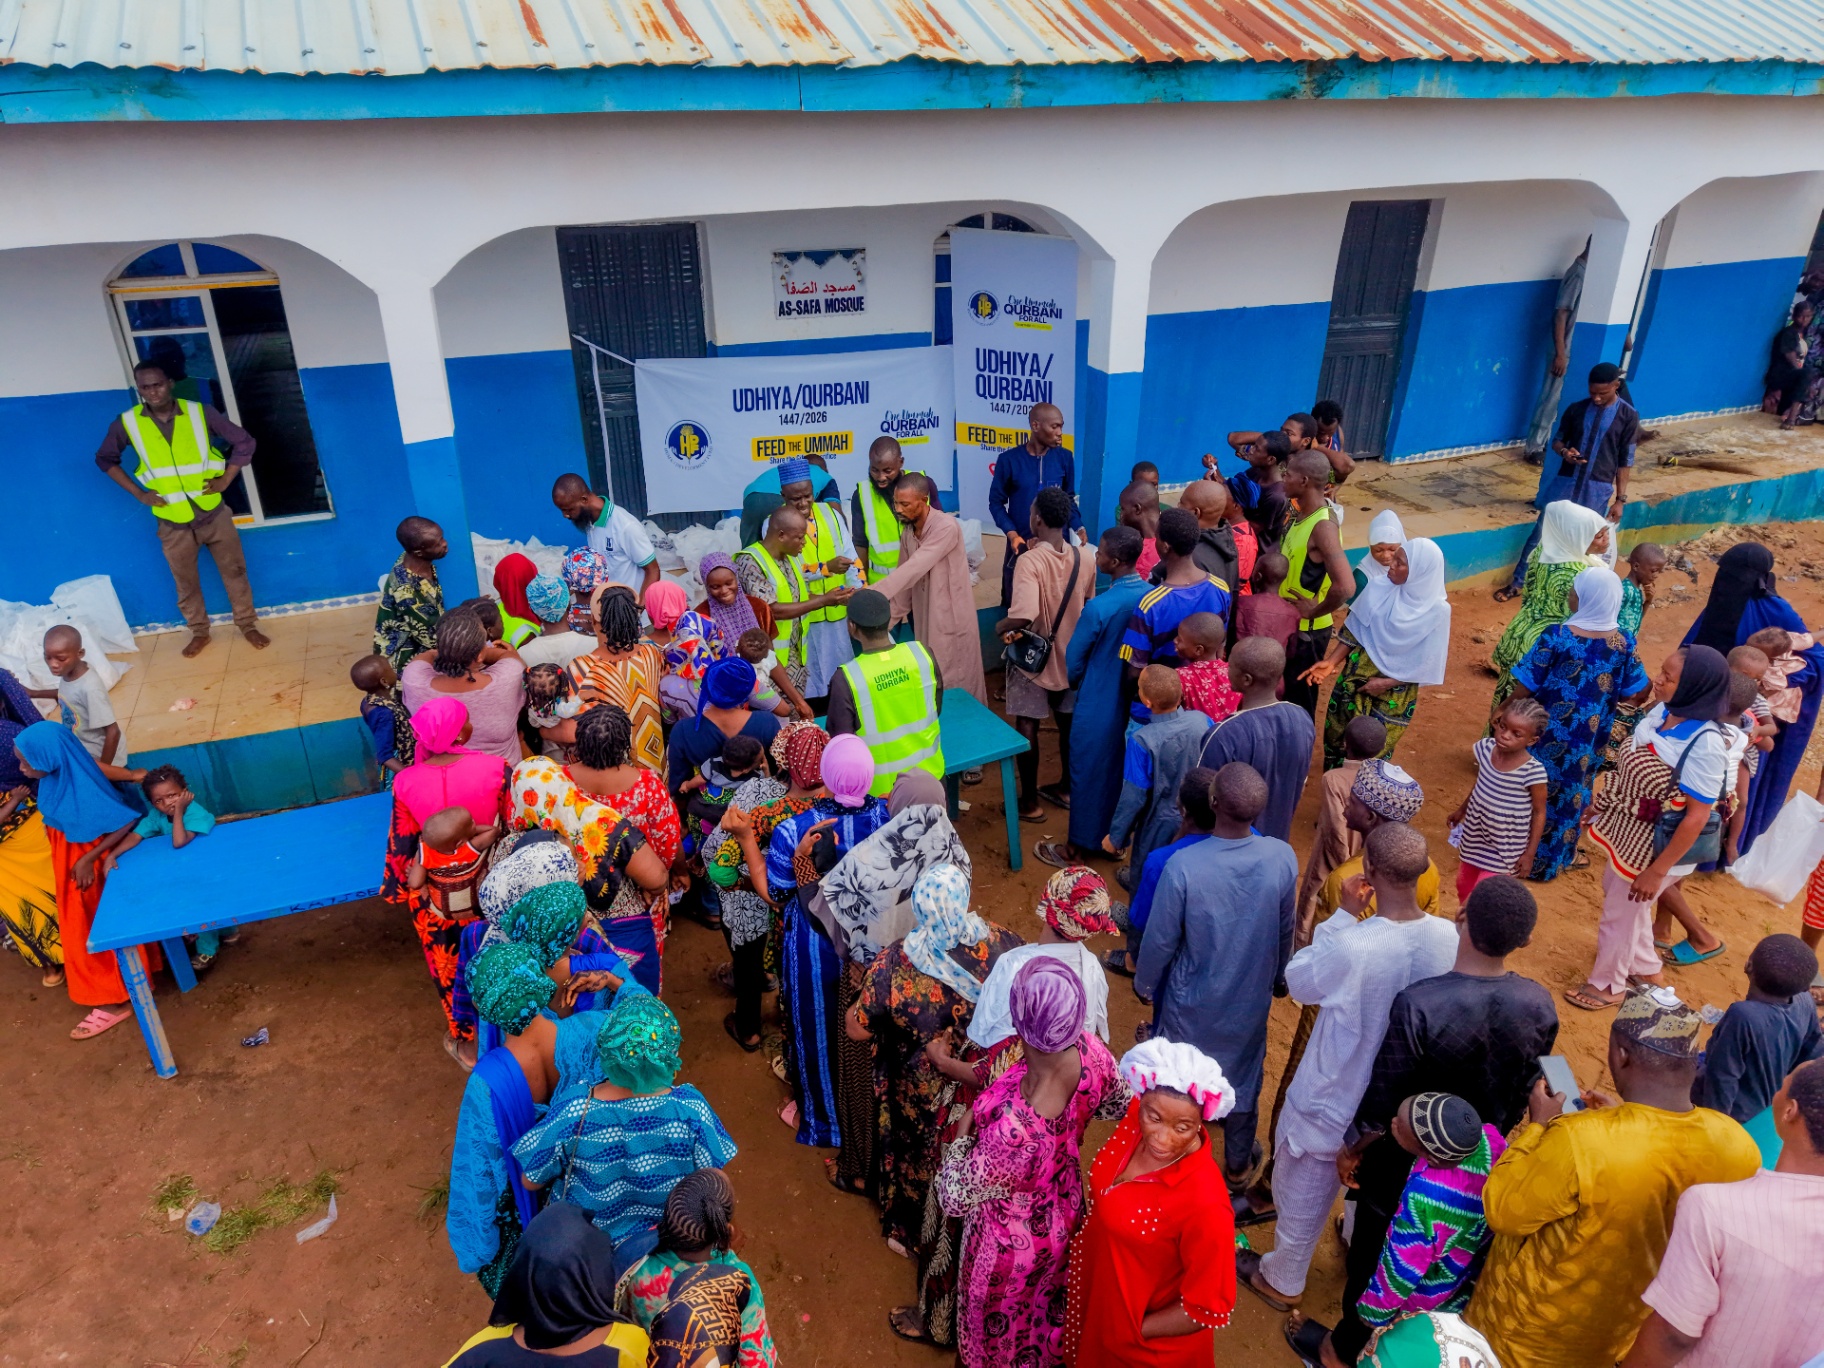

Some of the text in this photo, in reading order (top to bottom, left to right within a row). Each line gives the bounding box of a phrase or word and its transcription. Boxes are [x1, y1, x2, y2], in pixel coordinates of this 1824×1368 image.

[823, 283, 856, 296] مسجد
[778, 296, 865, 317] AS-SAFA MOSQUE
[1003, 303, 1063, 320] QURBANI
[1033, 316, 1047, 324] ALL
[975, 347, 1054, 380] UDHIYA/
[732, 380, 870, 412] UDHIYA/QURBANI
[975, 373, 1053, 404] QURBANI
[990, 401, 1032, 416] 1447/20
[778, 411, 828, 426] 1447/2026
[880, 415, 940, 434] QURBANI
[911, 429, 924, 437] ALL
[967, 425, 997, 445] FEED
[998, 433, 1013, 445] THE
[757, 433, 848, 458] FEED THE UMMAH
